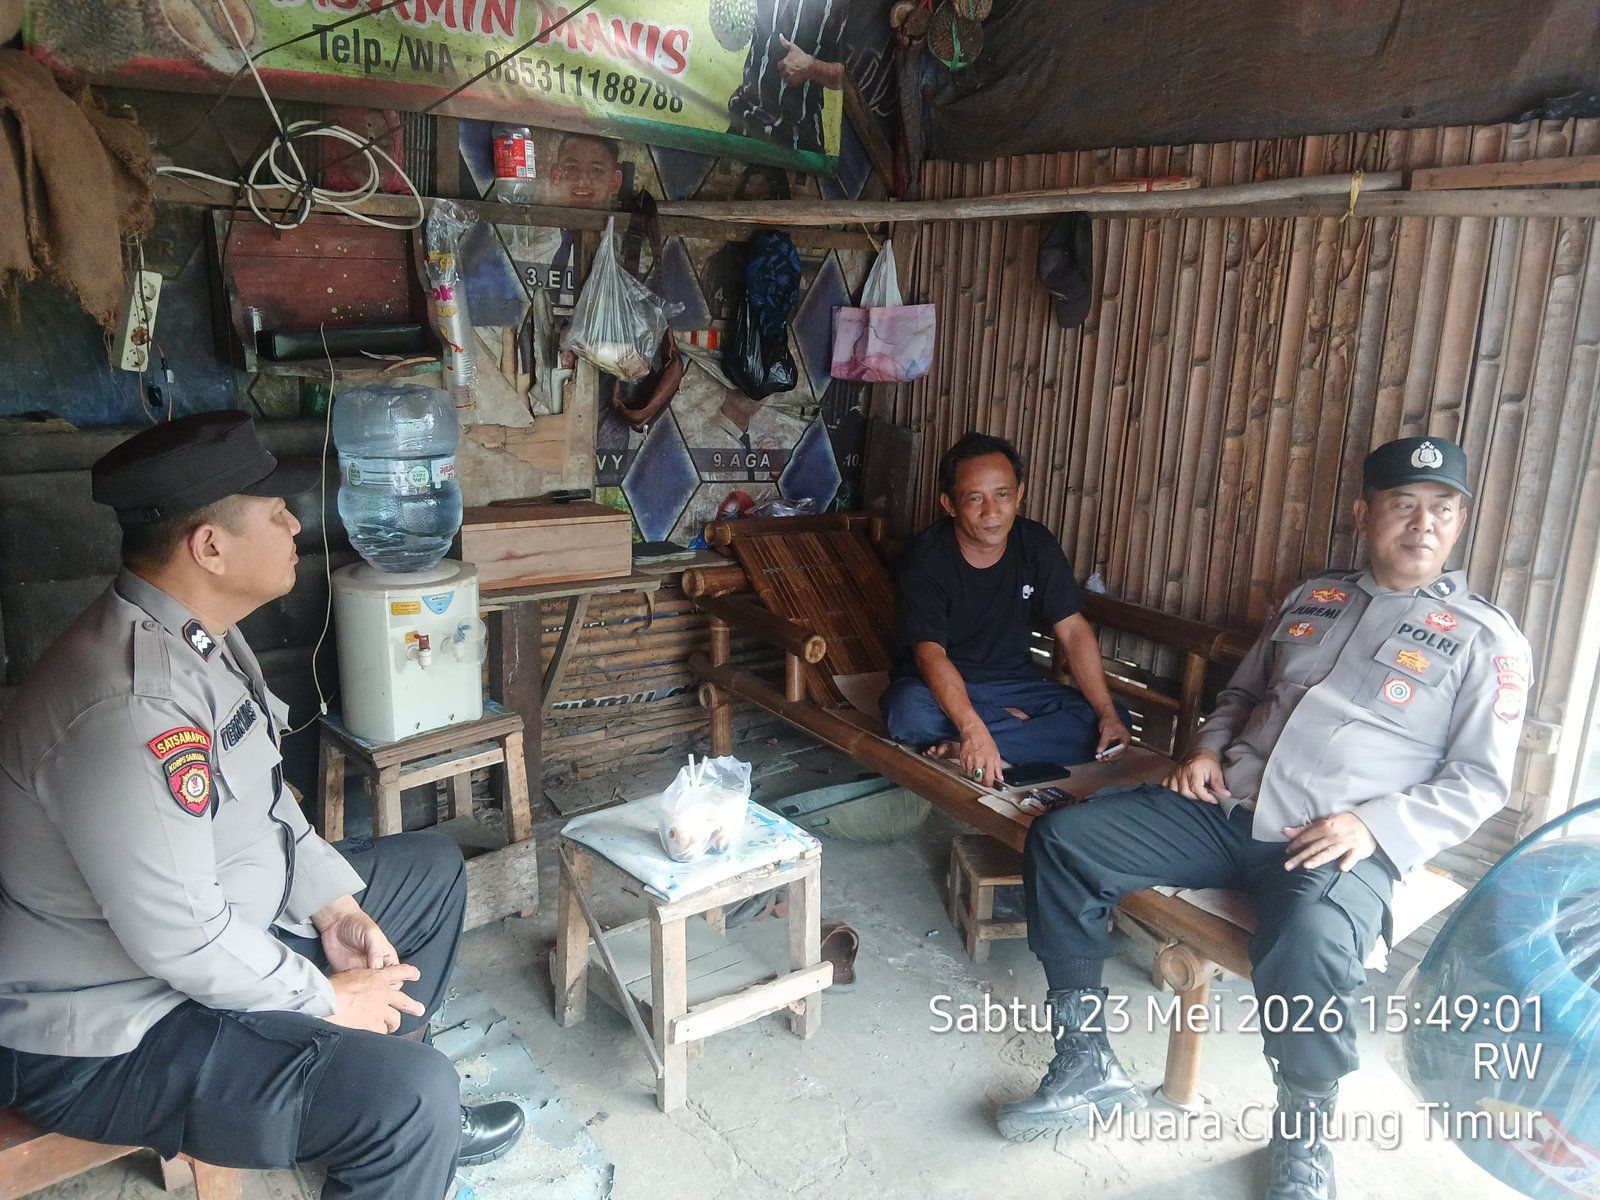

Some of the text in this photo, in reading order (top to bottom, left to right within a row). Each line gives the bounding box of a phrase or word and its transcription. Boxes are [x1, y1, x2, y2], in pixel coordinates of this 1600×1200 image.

[537, 5, 689, 75] MANIS
[485, 50, 683, 113] 085311188788
[729, 453, 771, 468] AGA
[1398, 623, 1460, 656] POLRI
